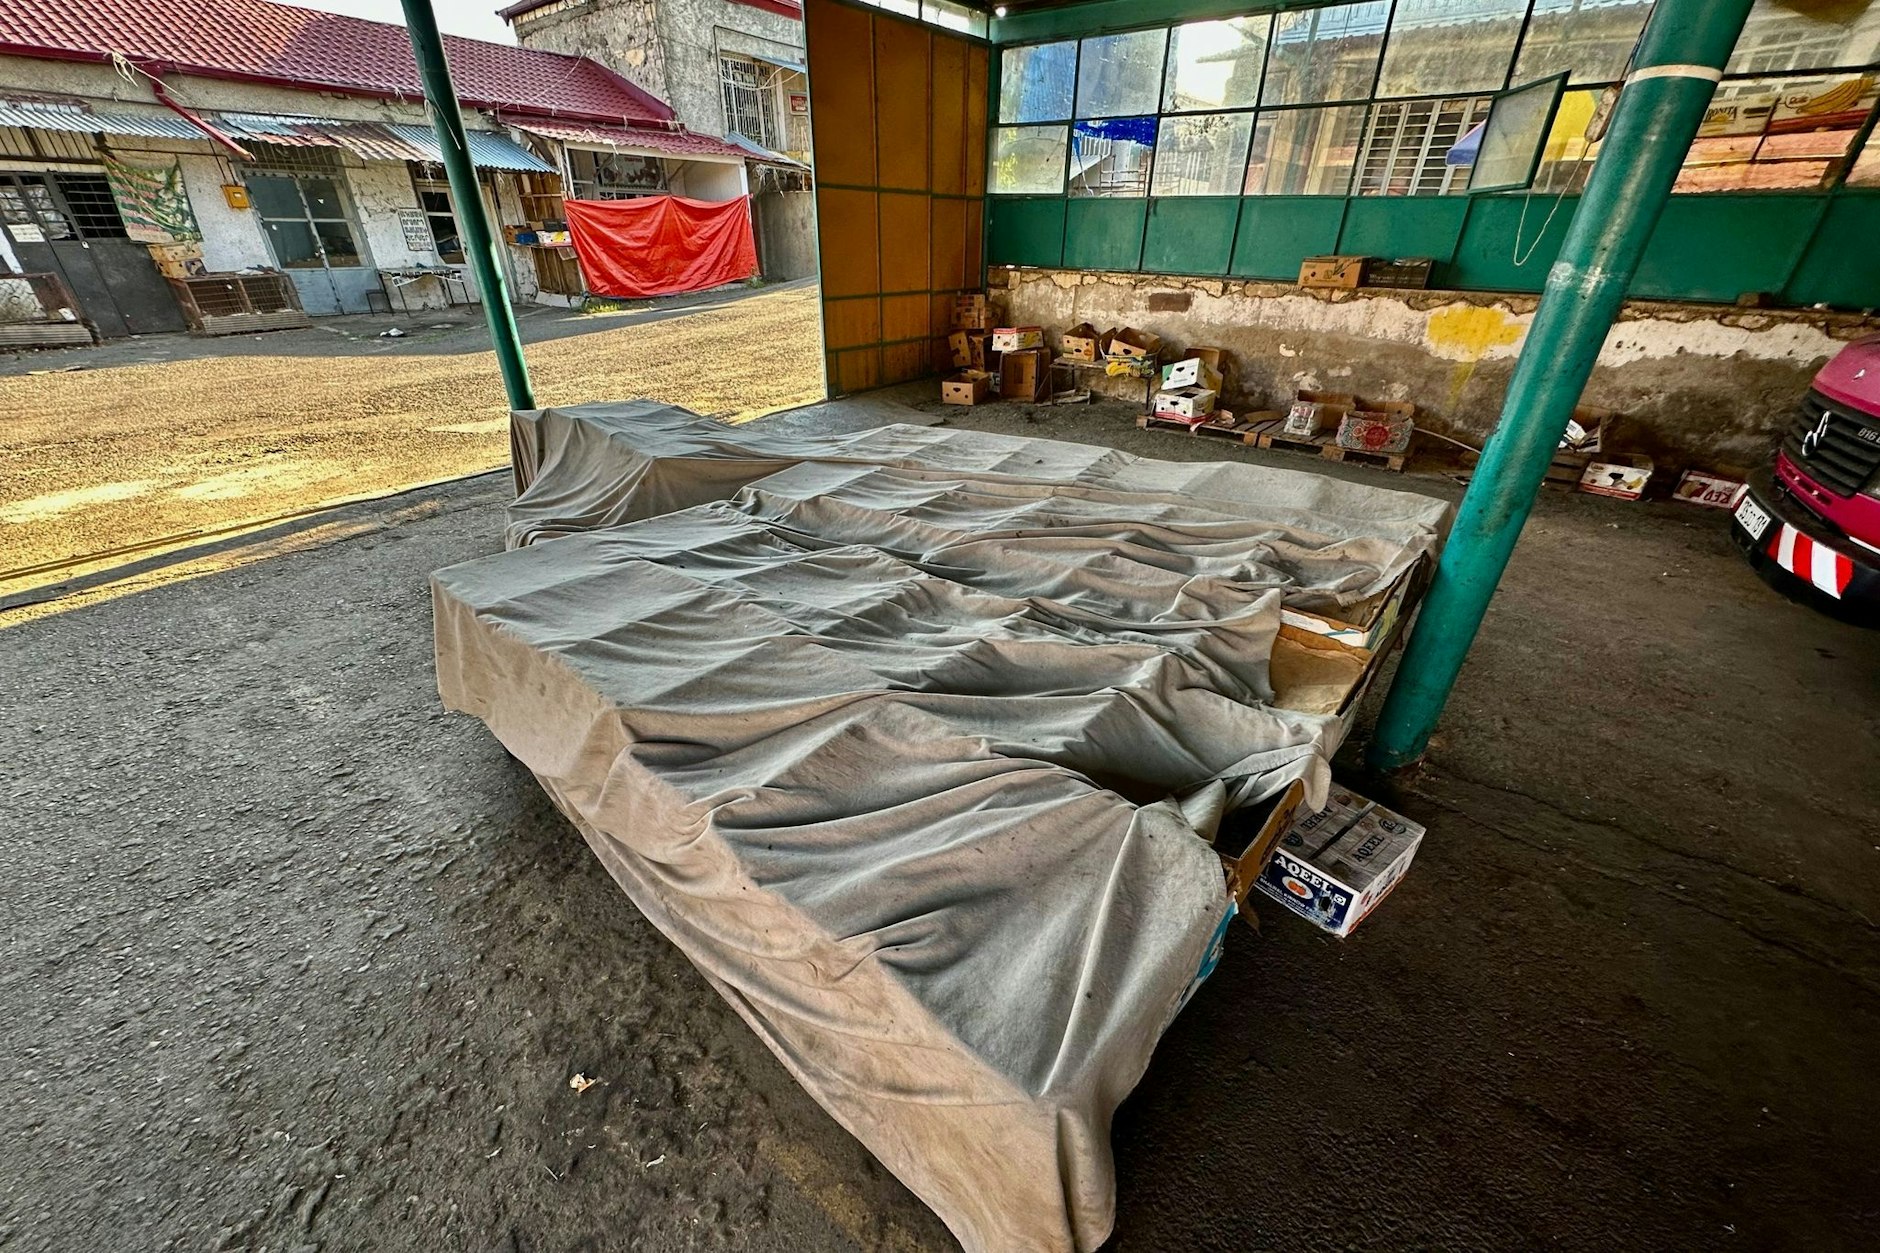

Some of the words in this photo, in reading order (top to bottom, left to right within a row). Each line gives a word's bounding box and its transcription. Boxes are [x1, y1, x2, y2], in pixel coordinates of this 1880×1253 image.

[1704, 489, 1733, 504] RED
[1351, 834, 1384, 862] AQEEL
[1274, 855, 1332, 895] AQEEL
